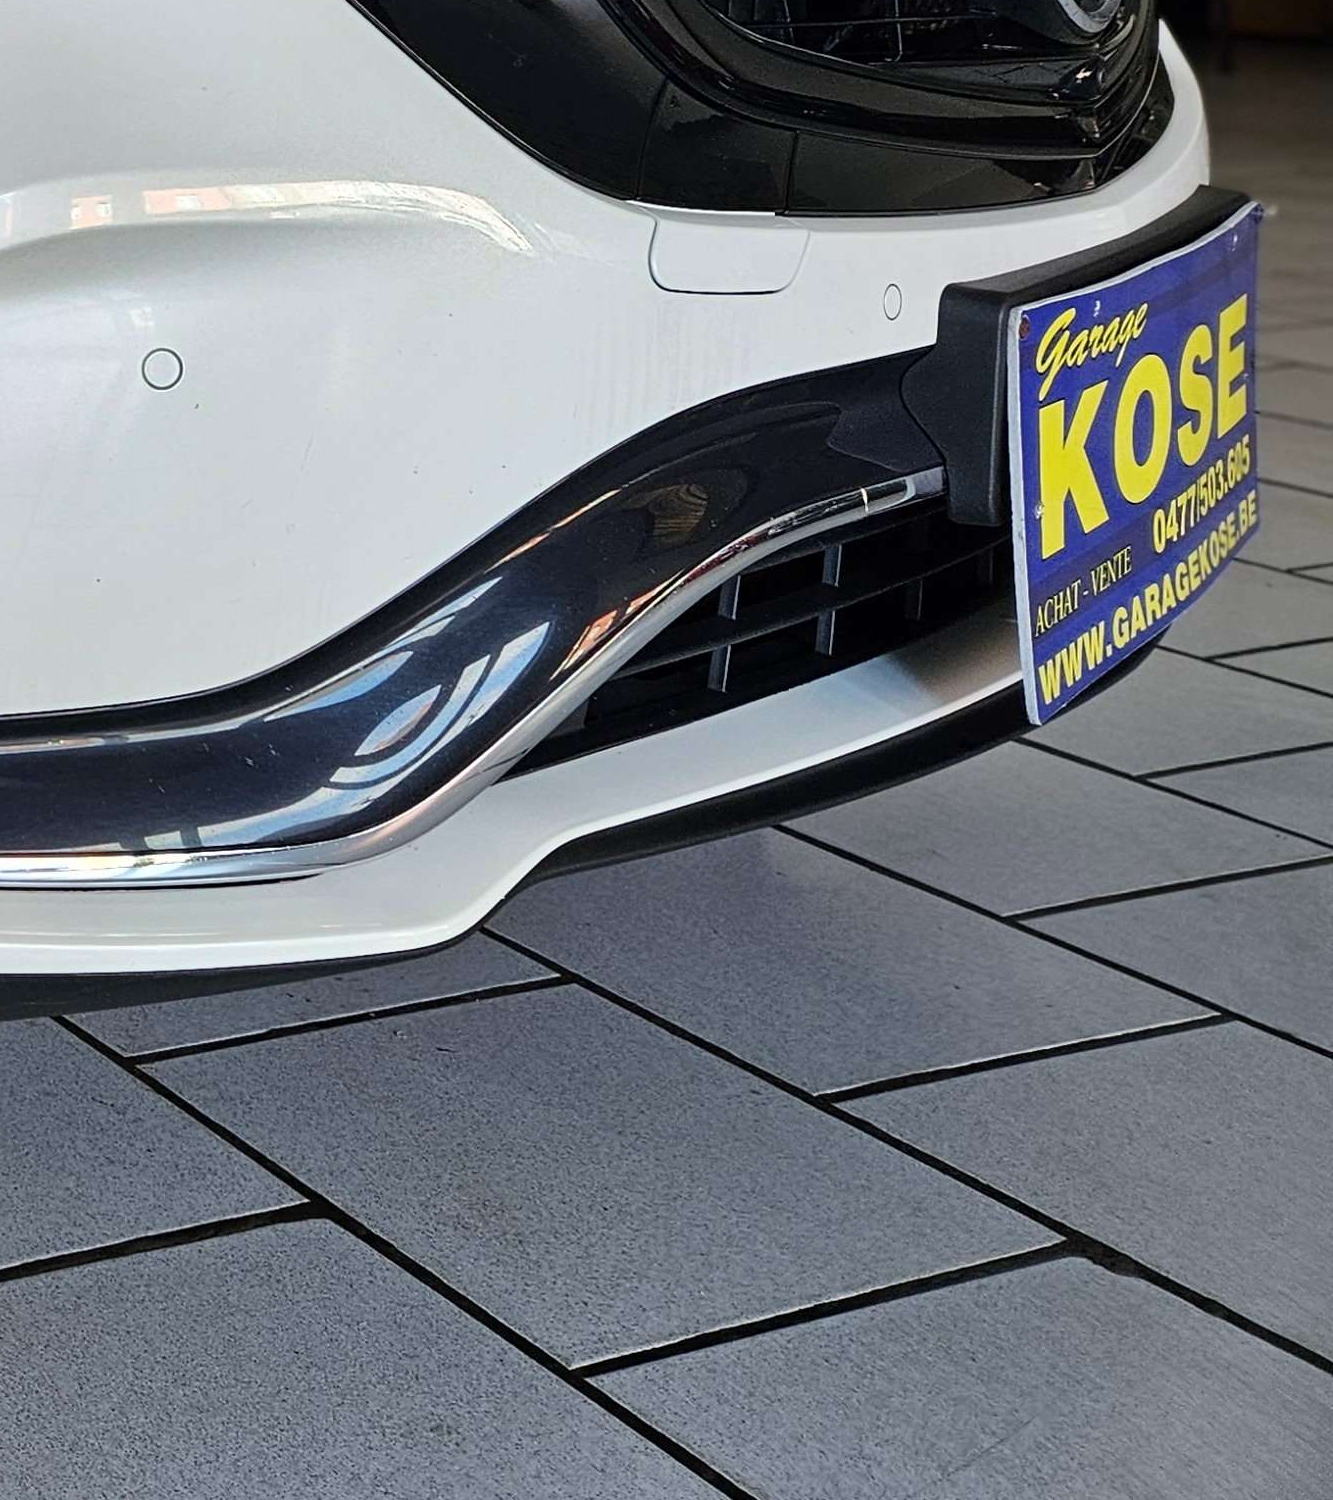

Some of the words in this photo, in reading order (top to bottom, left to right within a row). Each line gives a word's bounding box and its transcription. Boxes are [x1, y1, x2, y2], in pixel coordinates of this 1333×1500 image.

[1035, 302, 1149, 402] Garage
[1038, 293, 1248, 560] KOSE
[1034, 579, 1083, 638] ACHAT
[1091, 545, 1133, 597] VENTE
[1037, 489, 1258, 706] WWW.GARAGEKOSE.BE
